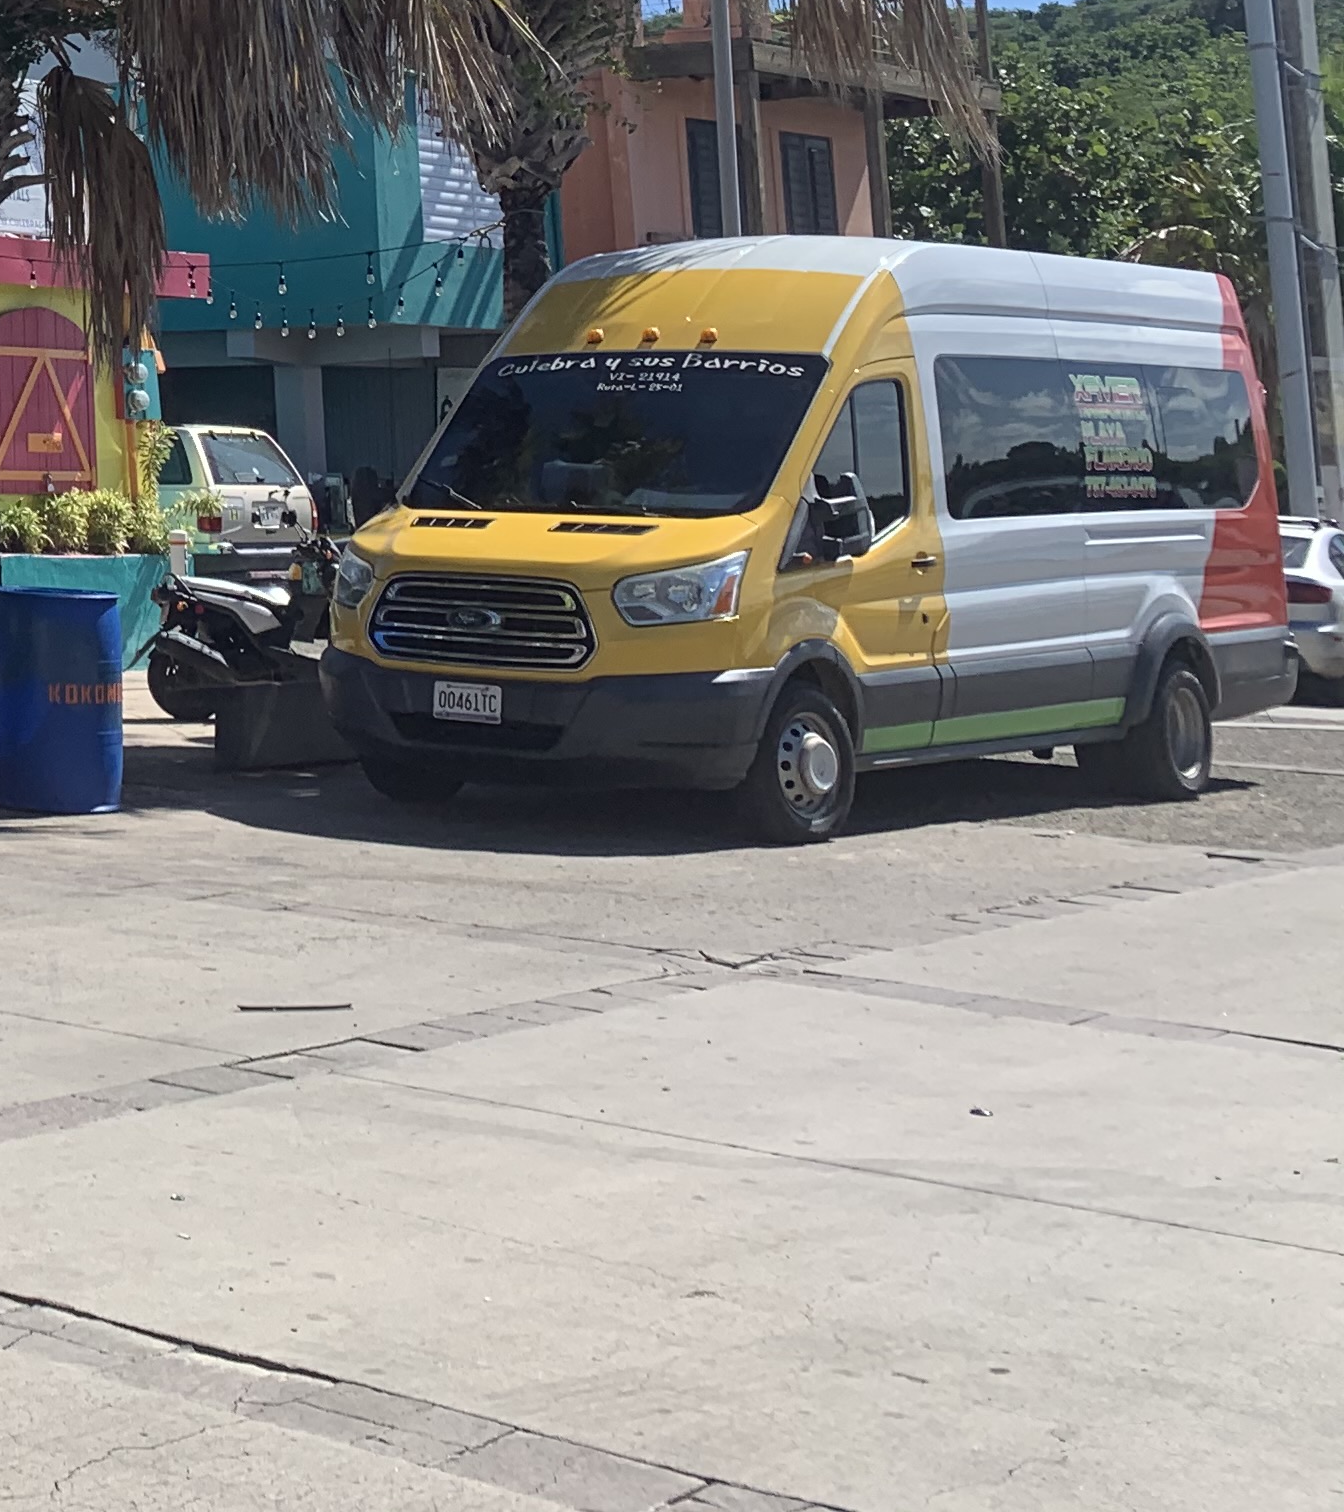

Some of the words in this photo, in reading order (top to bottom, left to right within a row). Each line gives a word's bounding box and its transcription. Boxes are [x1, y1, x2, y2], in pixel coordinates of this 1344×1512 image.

[498, 356, 596, 377] Culebra
[605, 357, 622, 372] y
[628, 357, 676, 368] sus
[681, 352, 805, 377] Barrios
[438, 690, 498, 714] 00461TC
